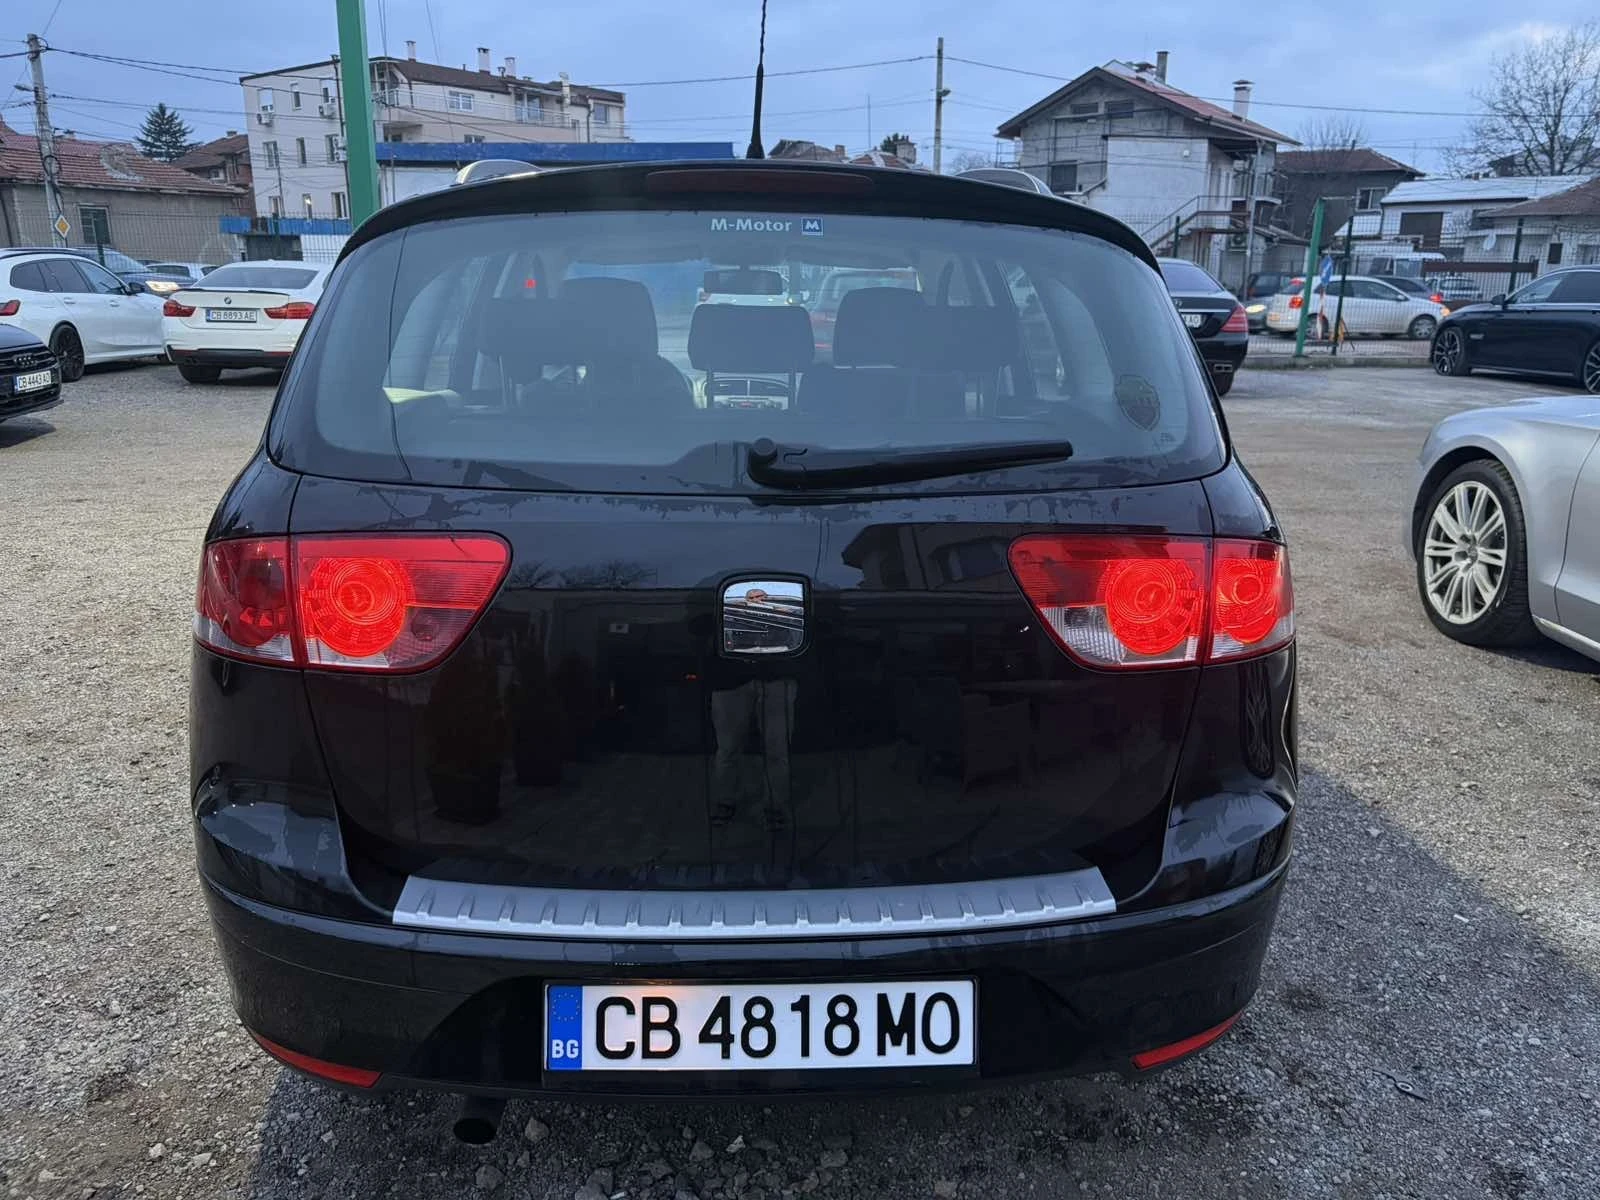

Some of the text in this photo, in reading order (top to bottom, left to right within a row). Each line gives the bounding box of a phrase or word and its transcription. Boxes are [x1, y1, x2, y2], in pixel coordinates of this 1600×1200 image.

[711, 217, 793, 232] M-Motor
[211, 311, 222, 320] CB
[596, 991, 960, 1059] CB 4818 MO
[551, 1039, 579, 1059] BG
